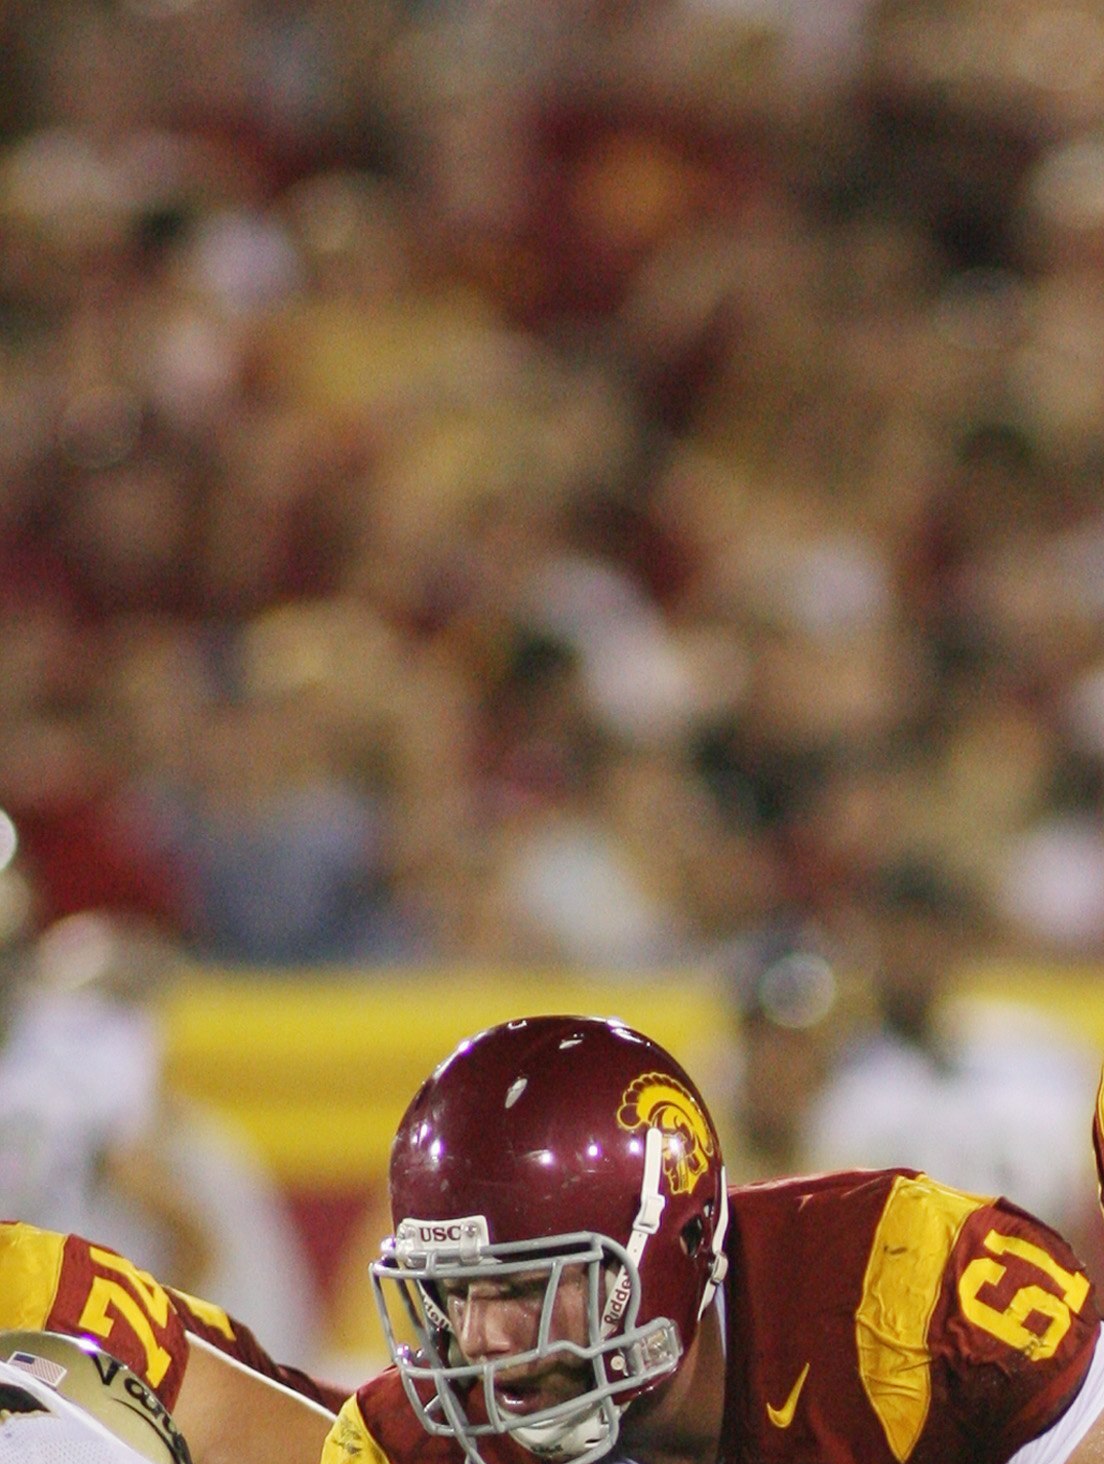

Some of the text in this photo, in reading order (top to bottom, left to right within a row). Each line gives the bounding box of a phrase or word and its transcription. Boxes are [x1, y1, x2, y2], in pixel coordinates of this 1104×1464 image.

[419, 1225, 461, 1242] USC
[603, 1277, 632, 1326] Ridde
[958, 1229, 1091, 1362] 61
